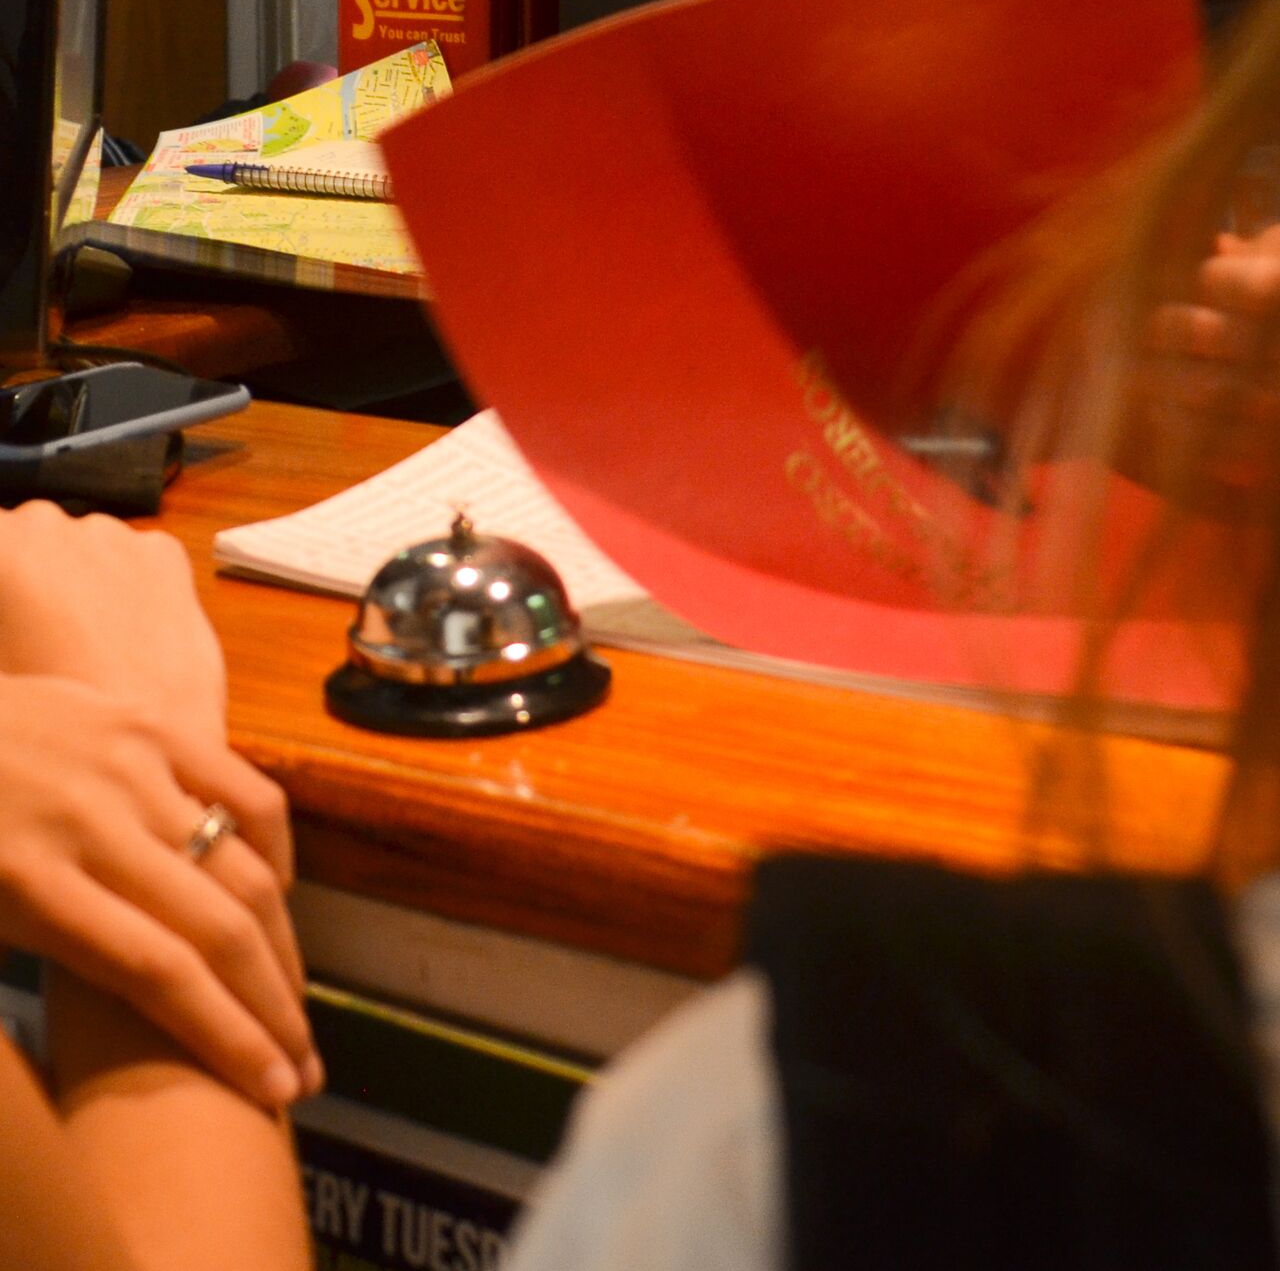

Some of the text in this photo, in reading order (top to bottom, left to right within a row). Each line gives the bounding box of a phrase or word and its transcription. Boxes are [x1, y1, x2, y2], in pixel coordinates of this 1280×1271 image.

[379, 24, 466, 44] You can Trust
